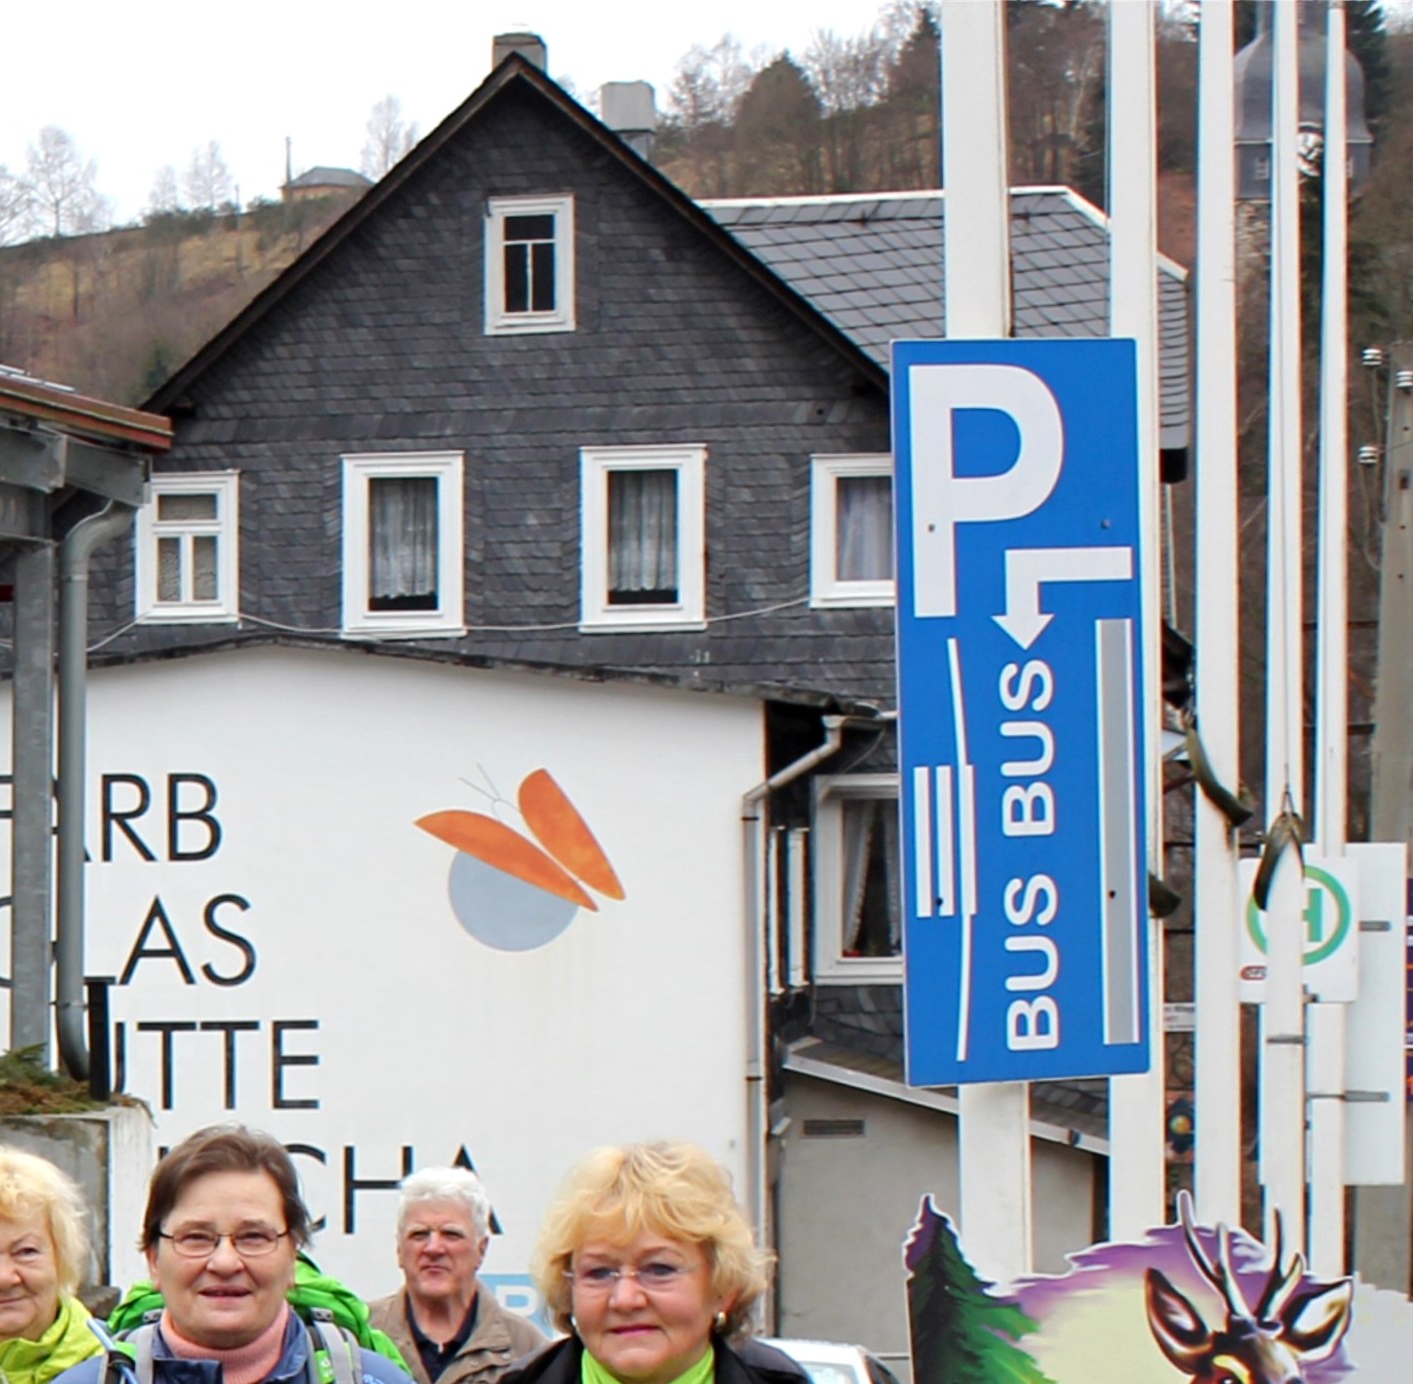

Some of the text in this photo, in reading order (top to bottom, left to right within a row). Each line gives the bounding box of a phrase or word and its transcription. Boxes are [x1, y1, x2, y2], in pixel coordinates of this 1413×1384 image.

[908, 363, 1065, 618] P
[998, 658, 1060, 1051] BUS BUS
